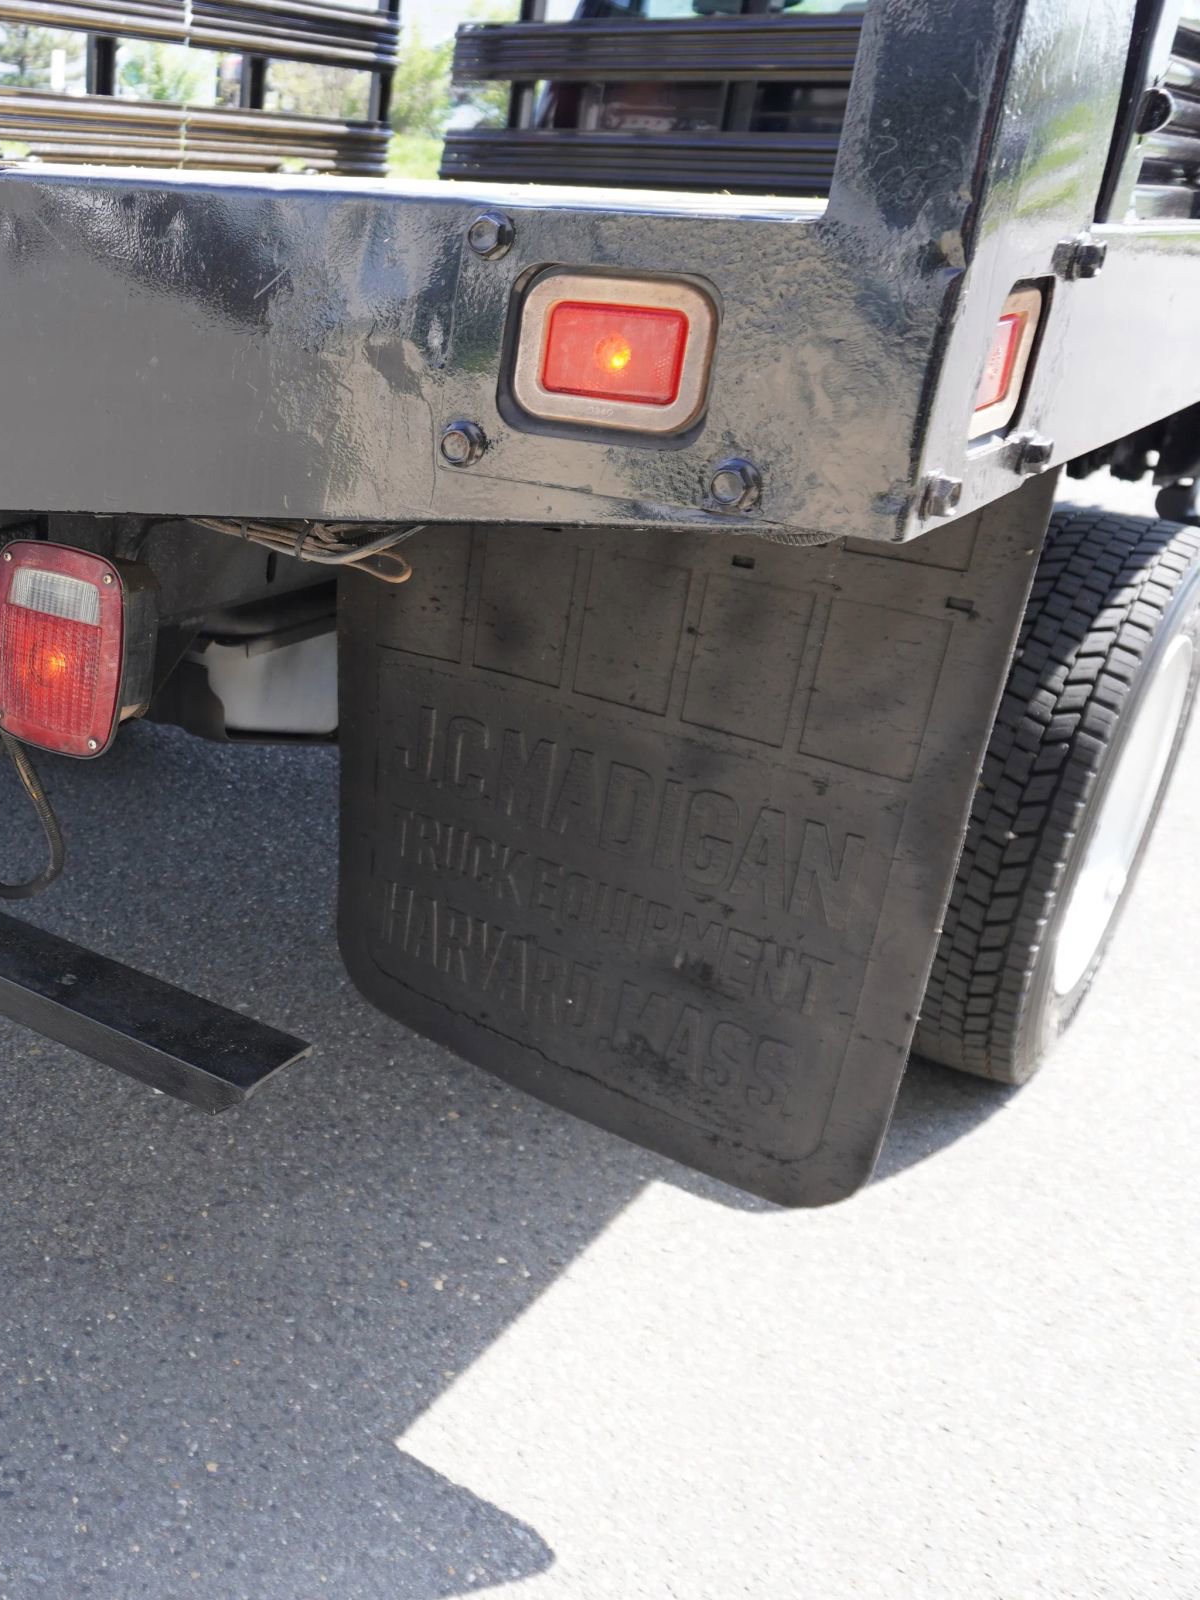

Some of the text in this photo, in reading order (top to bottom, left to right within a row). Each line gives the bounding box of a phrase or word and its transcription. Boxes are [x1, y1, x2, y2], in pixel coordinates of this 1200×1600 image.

[390, 800, 837, 1015] TRUCK EQUIPMENT
[494, 726, 868, 930] MADIGAN
